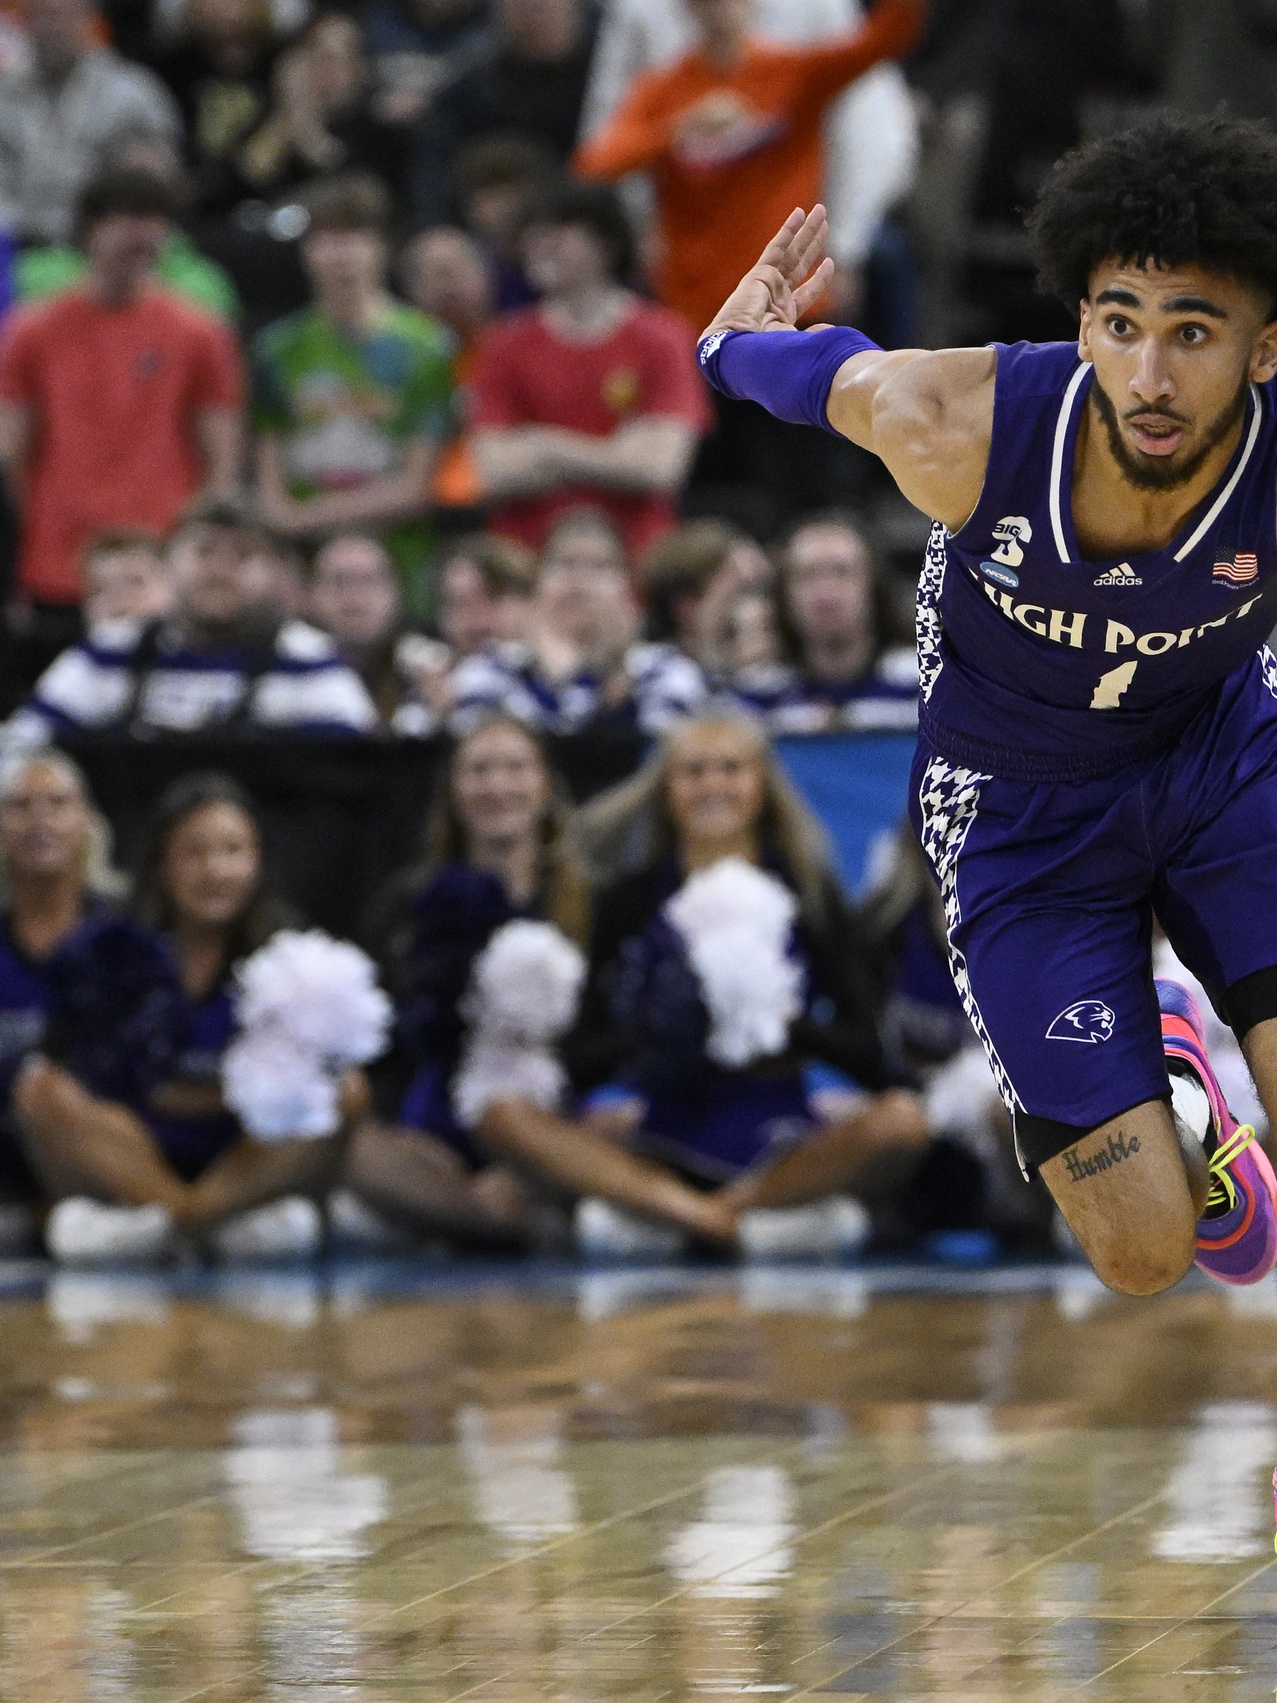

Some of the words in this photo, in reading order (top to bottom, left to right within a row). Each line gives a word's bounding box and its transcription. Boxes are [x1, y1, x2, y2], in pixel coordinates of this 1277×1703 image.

[993, 523, 1021, 538] BIG
[1093, 575, 1143, 586] adidas
[1089, 660, 1138, 709] 1
[1062, 1131, 1141, 1182] Humble
